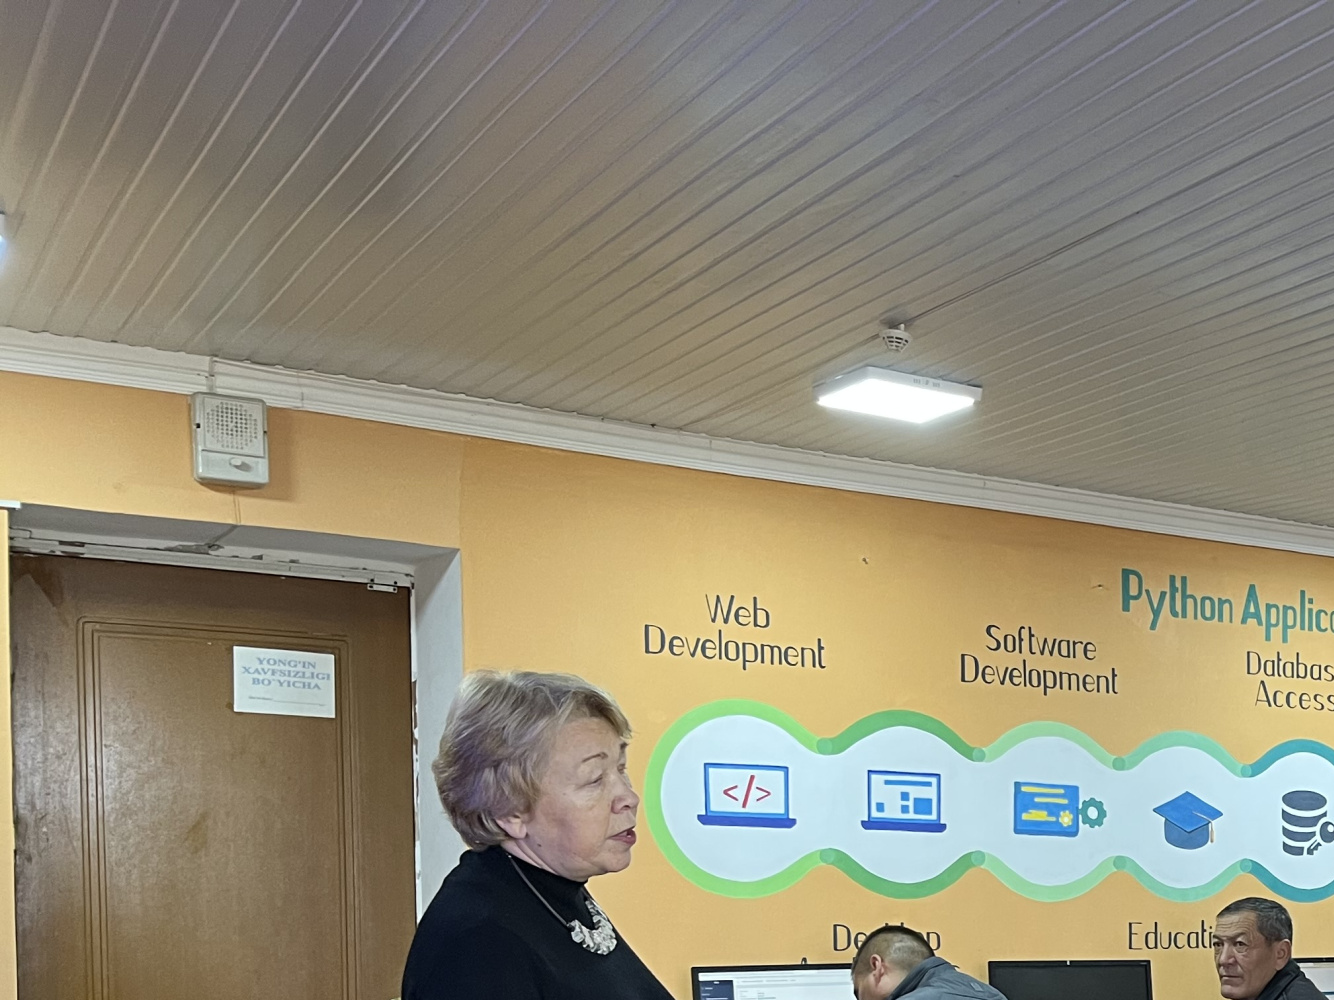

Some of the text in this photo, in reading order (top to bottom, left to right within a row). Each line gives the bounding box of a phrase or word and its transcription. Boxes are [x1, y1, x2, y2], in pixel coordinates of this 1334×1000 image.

[705, 593, 770, 629] Web
[1121, 567, 1233, 631] Python
[644, 623, 827, 671] Development
[985, 624, 1097, 661] Software
[242, 666, 331, 681] XAVFSIZLIGI
[960, 653, 1119, 697] Development
[1128, 919, 1214, 950] Educati
